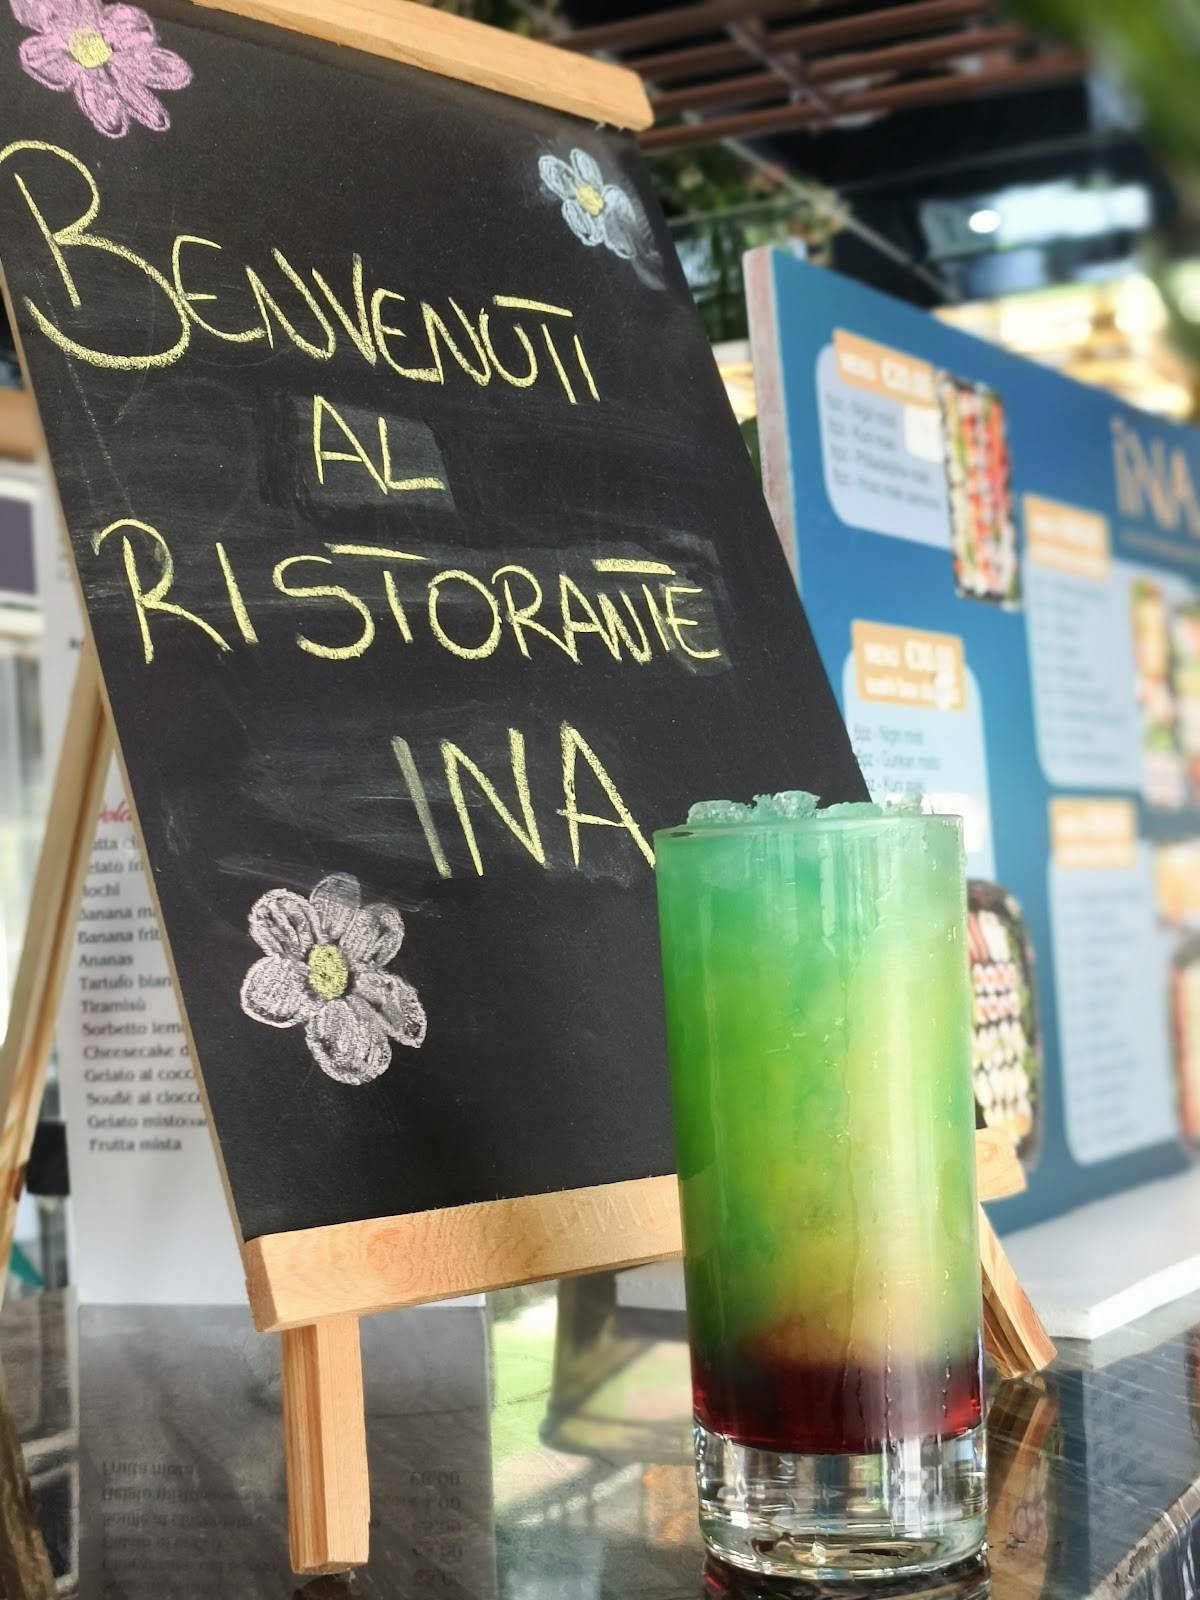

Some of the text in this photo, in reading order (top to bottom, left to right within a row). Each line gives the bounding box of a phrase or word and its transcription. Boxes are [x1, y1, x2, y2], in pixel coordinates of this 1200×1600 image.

[0, 140, 601, 404] BENVENUTI
[313, 395, 446, 494] AL
[93, 518, 722, 666] RISTORANTE
[390, 720, 656, 878] INA
[77, 929, 134, 945] Banana
[79, 953, 134, 967] Ananas
[79, 975, 133, 990] Tartufo
[82, 1022, 147, 1037] Sorbetto
[83, 1045, 174, 1060] Cheesecake
[84, 1068, 135, 1083] Gelato
[138, 1068, 153, 1081] al
[138, 1090, 151, 1105] al
[87, 1114, 138, 1129] Gelato
[90, 1137, 183, 1152] Frutta mista
